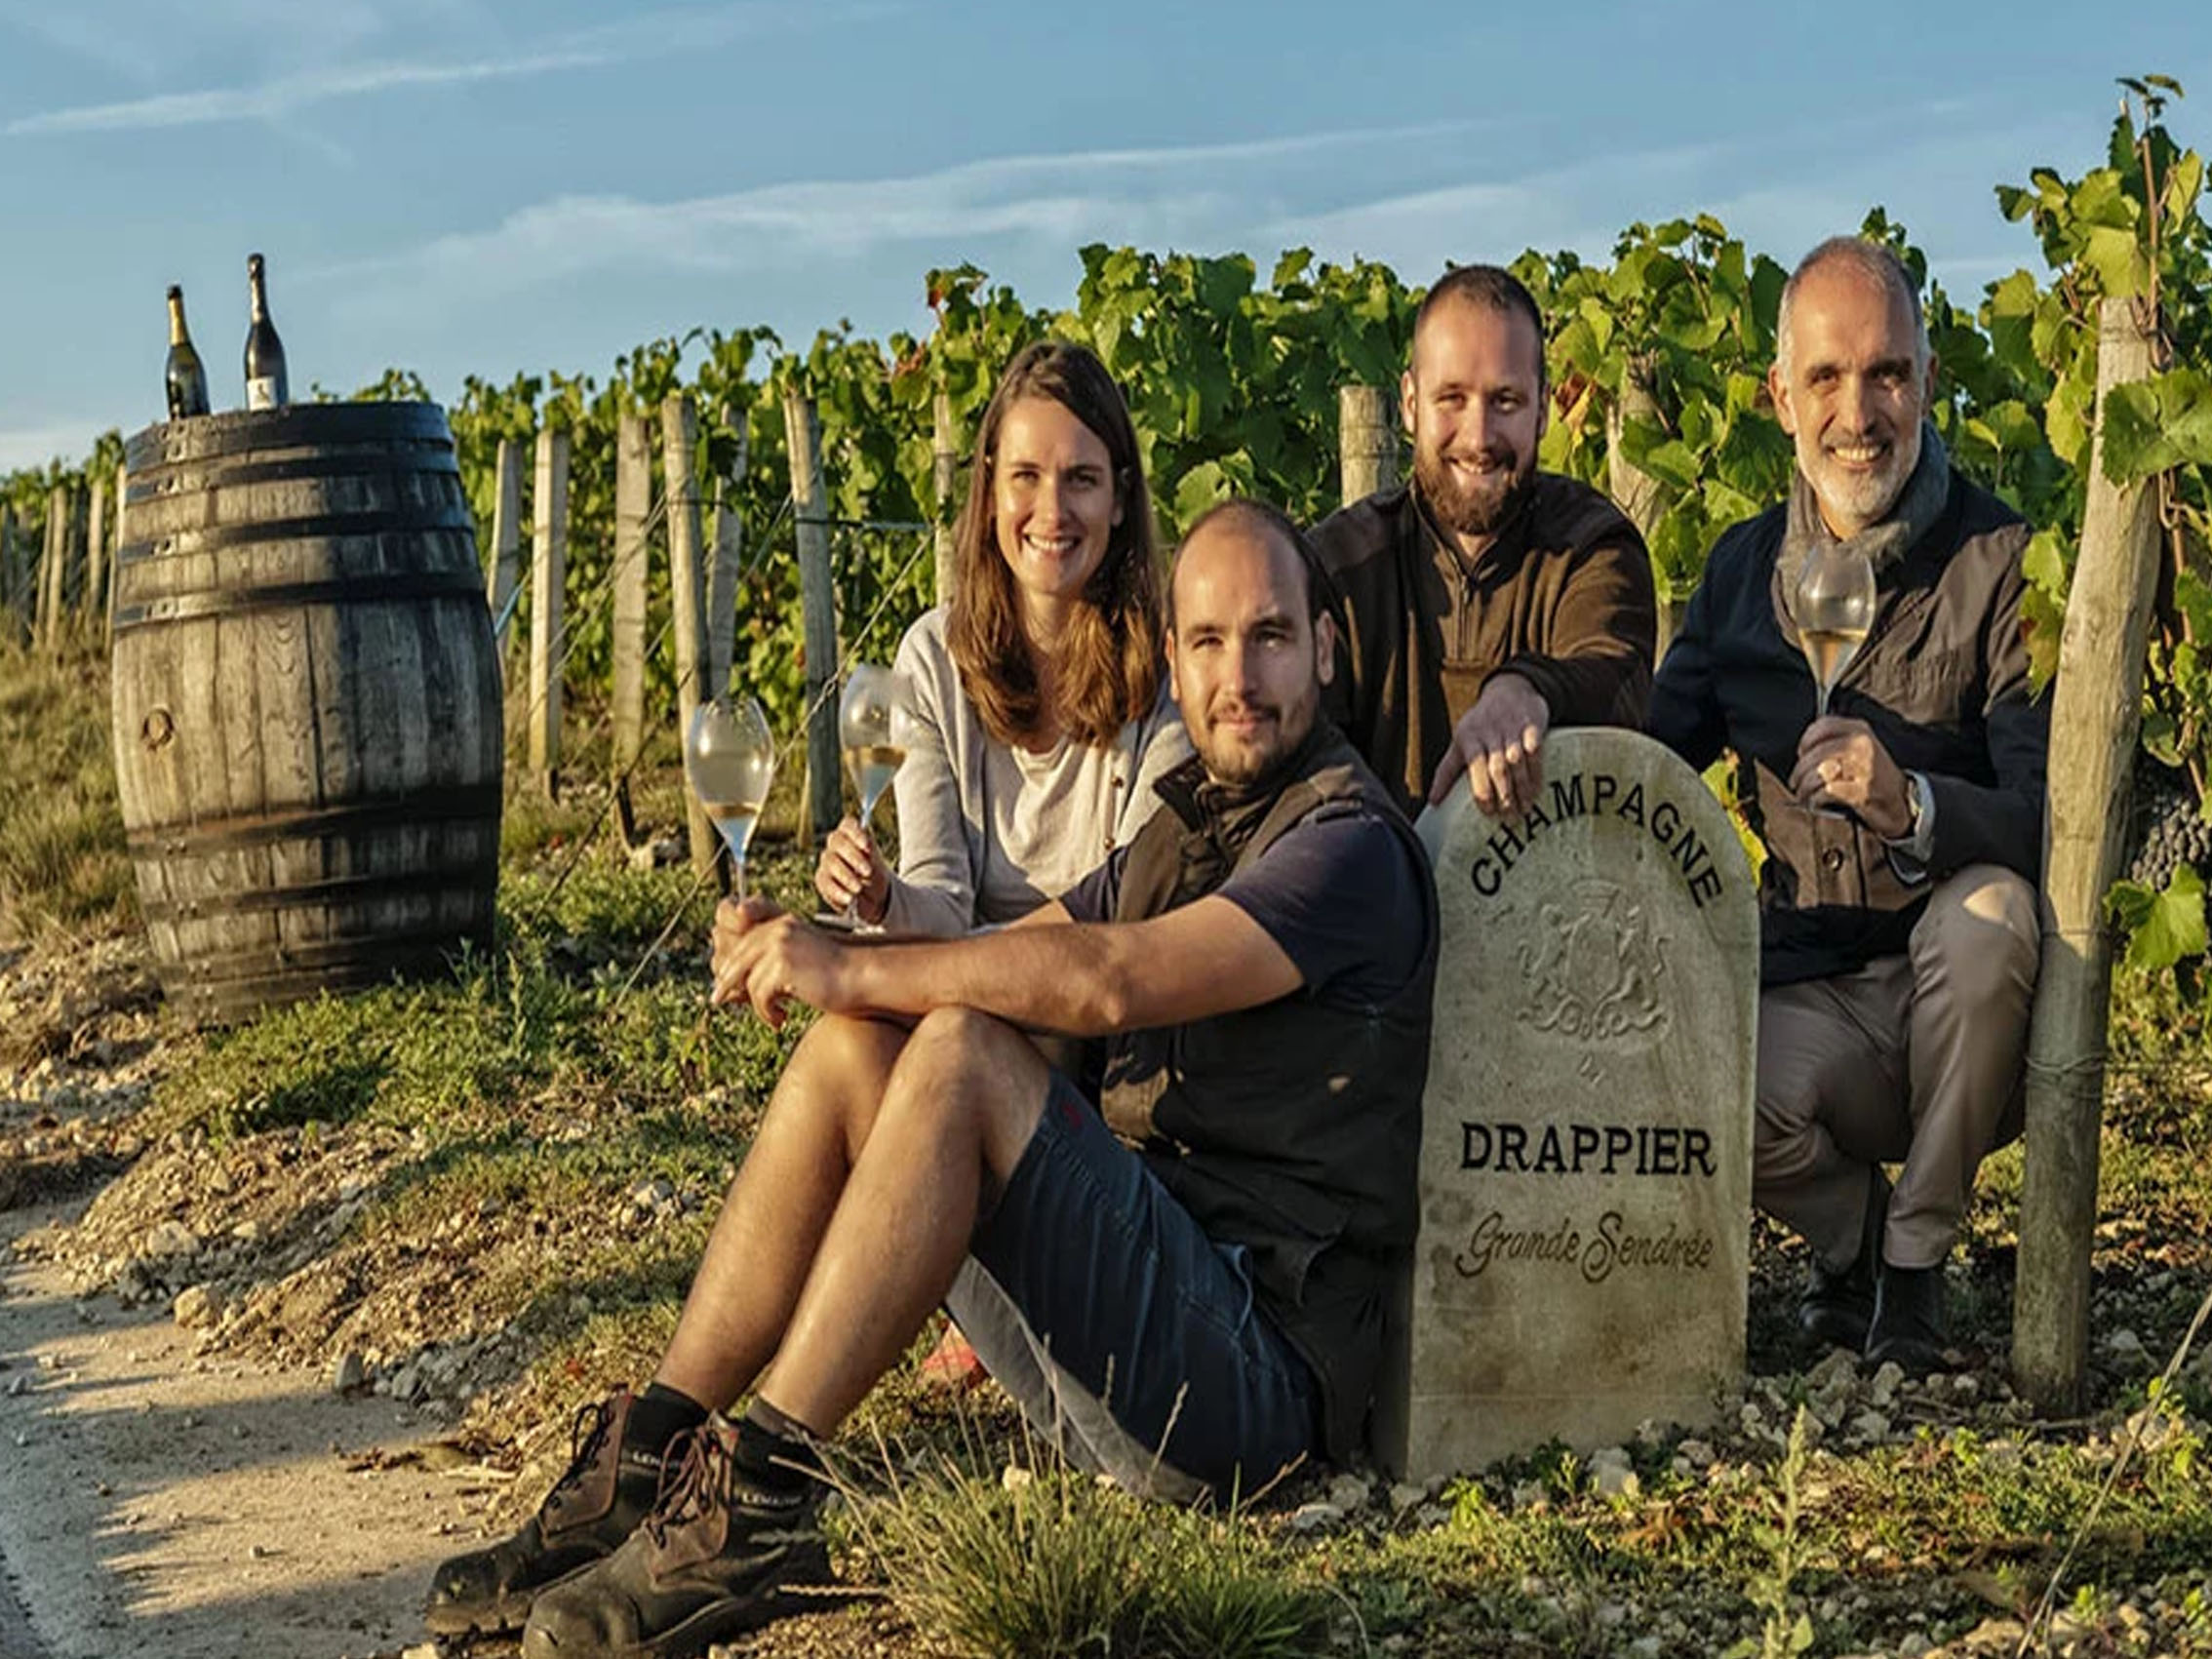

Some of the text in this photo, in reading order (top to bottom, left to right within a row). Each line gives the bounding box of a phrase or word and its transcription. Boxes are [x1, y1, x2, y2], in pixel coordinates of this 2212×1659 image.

[1472, 773, 1723, 907] CHAMPAGNE
[1460, 1122, 1718, 1177] DRAPPIER
[1455, 1210, 1714, 1284] Grande Sendrée
